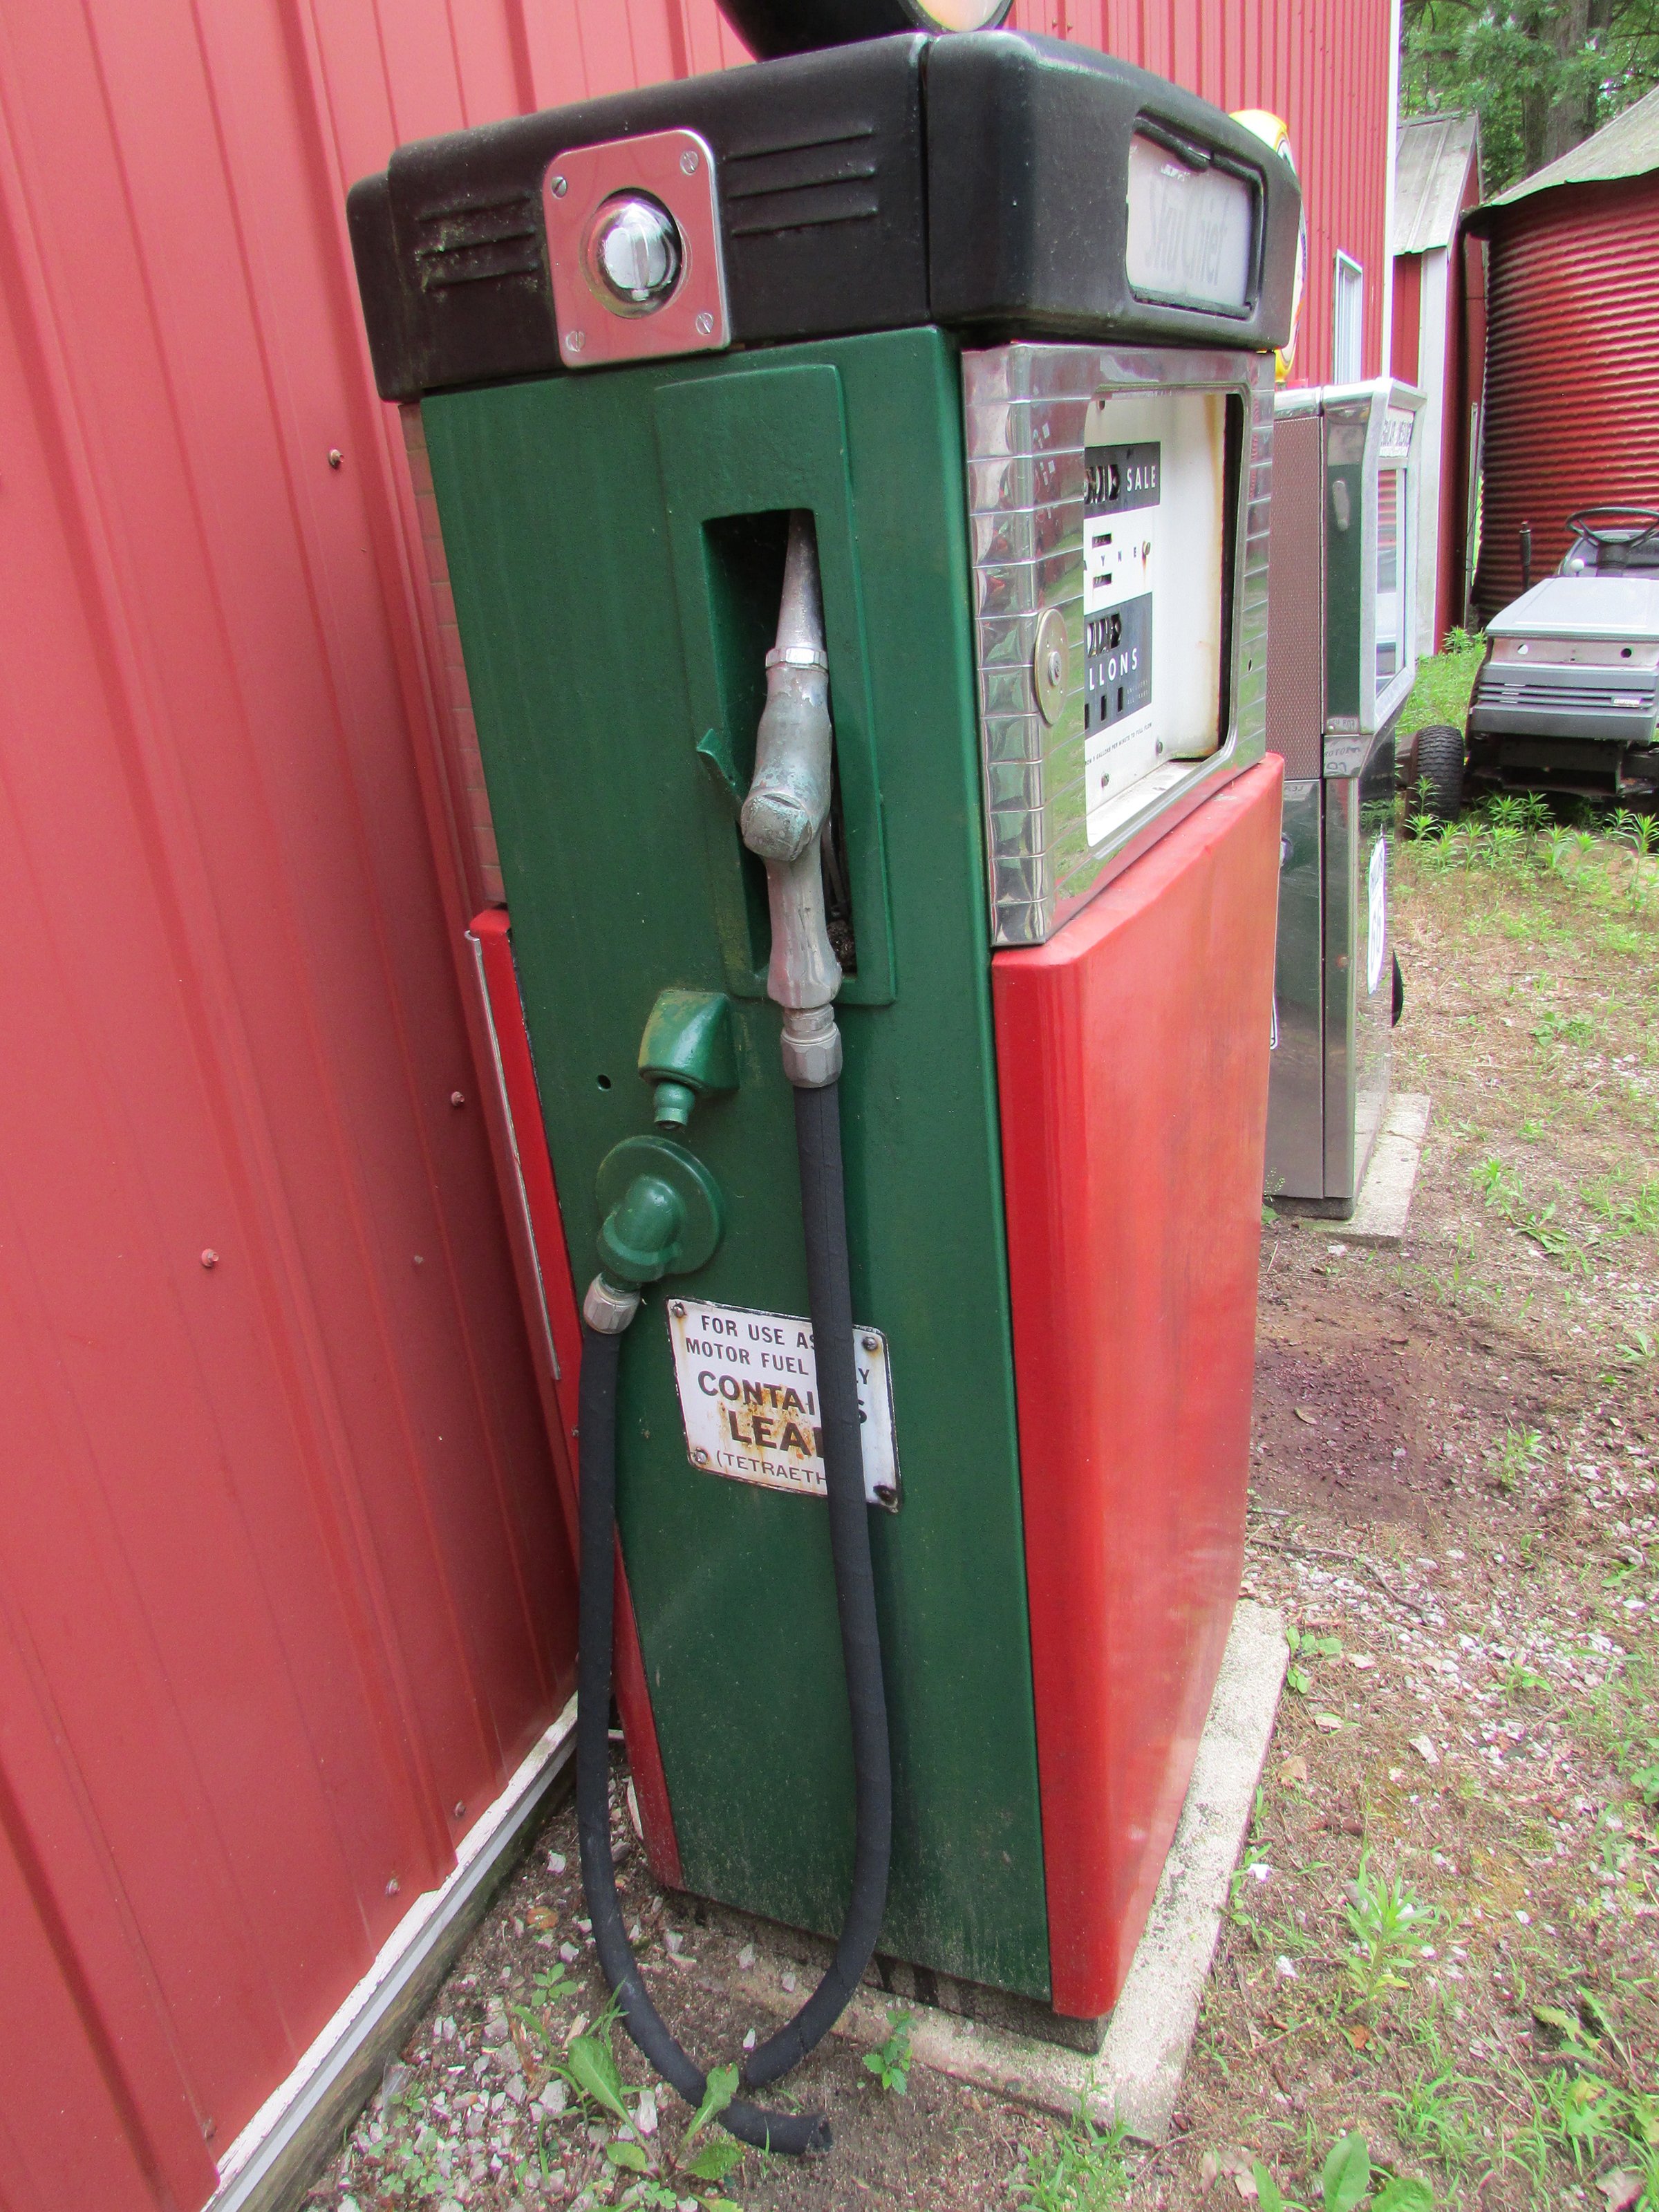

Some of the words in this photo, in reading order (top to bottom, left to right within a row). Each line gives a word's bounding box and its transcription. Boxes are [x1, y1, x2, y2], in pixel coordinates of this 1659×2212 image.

[1127, 465, 1156, 492] SALE
[1096, 747, 1111, 760] GALLONS
[701, 1315, 738, 1337] FOR
[748, 1323, 785, 1346] USE
[686, 1337, 751, 1365] MOTOR
[761, 1353, 809, 1376] FUEL
